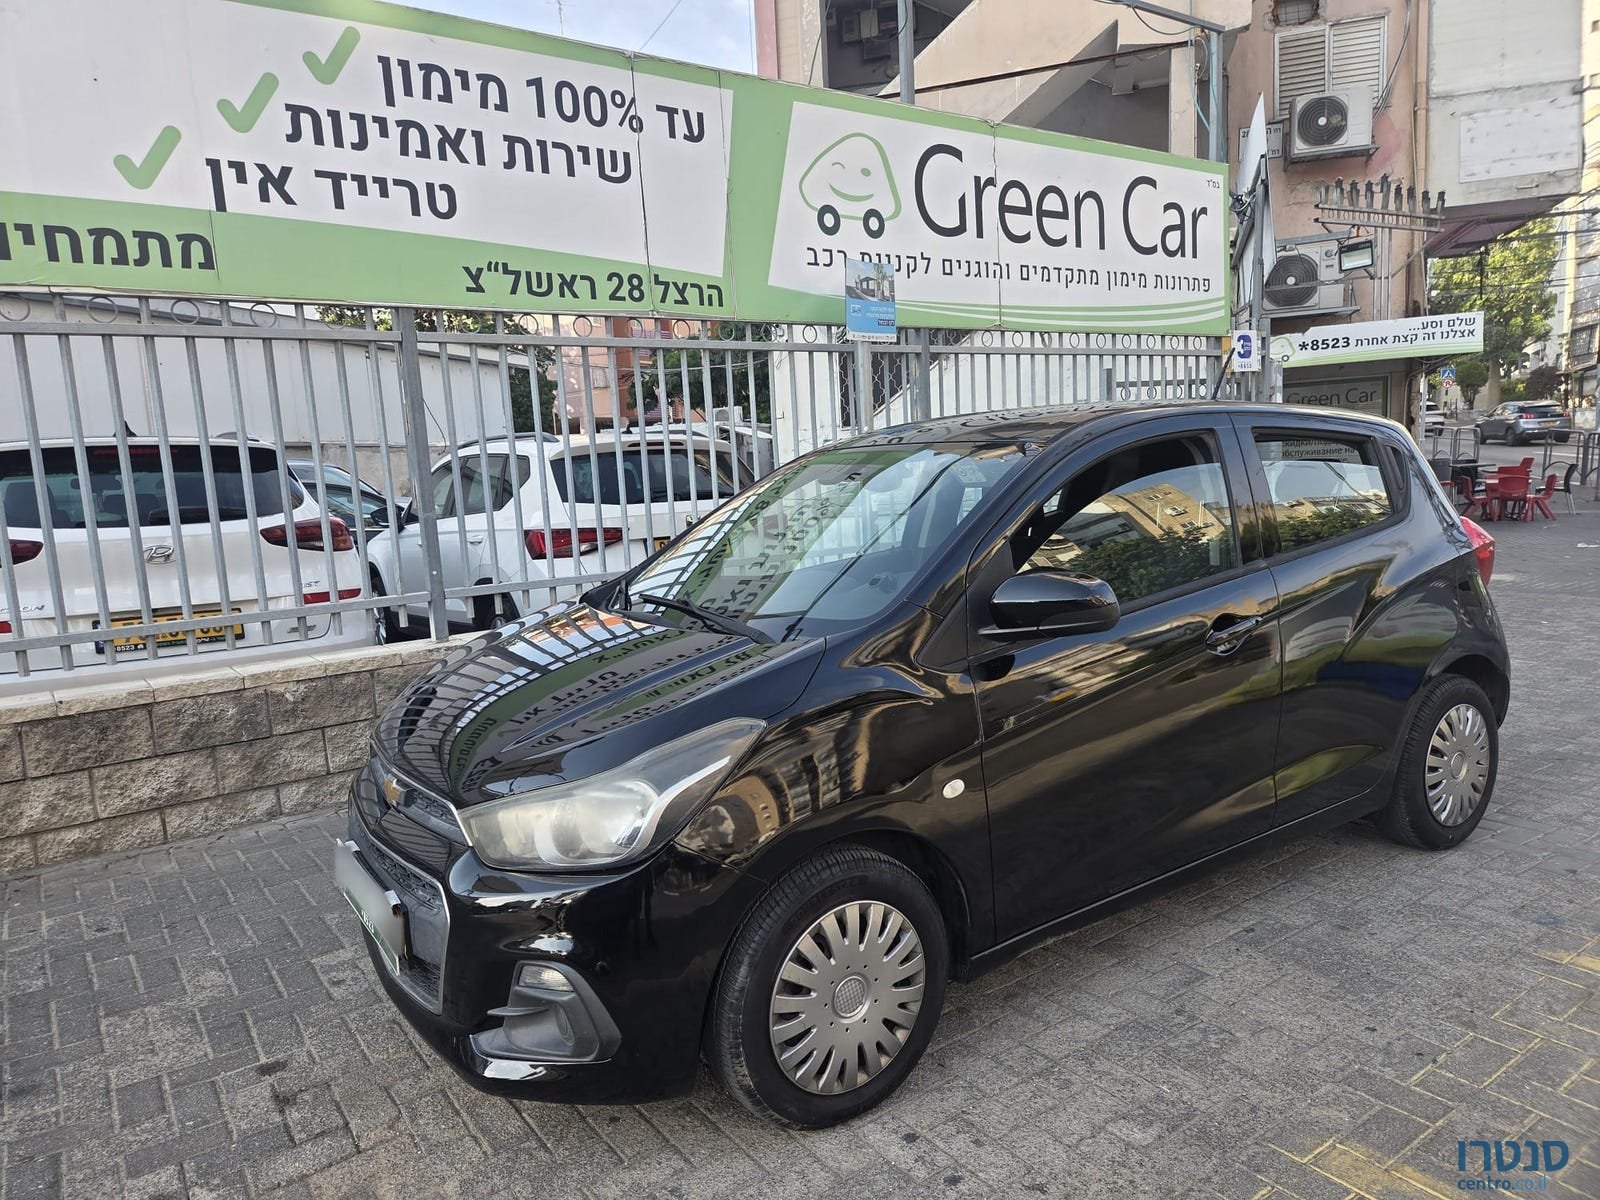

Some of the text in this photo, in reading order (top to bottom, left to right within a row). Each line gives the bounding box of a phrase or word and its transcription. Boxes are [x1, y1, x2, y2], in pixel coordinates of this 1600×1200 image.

[377, 55, 705, 144] עד 100% מימון
[284, 102, 632, 185] שירות ואמינות
[205, 157, 459, 221] טרייד אין
[914, 143, 1208, 260] Green Car
[931, 257, 1011, 281] והוגנים
[1019, 263, 1100, 290] מתקדמים
[1106, 269, 1147, 292] מימון
[605, 271, 646, 303] 28
[653, 273, 725, 308] הרצל
[1153, 273, 1211, 294] פתרונות
[1446, 315, 1476, 329] שלם
[1354, 335, 1389, 348] אחרת
[1391, 333, 1418, 346] קצת
[1422, 332, 1436, 342] זה
[1440, 327, 1476, 341] אצלנו
[1345, 387, 1377, 404] Car
